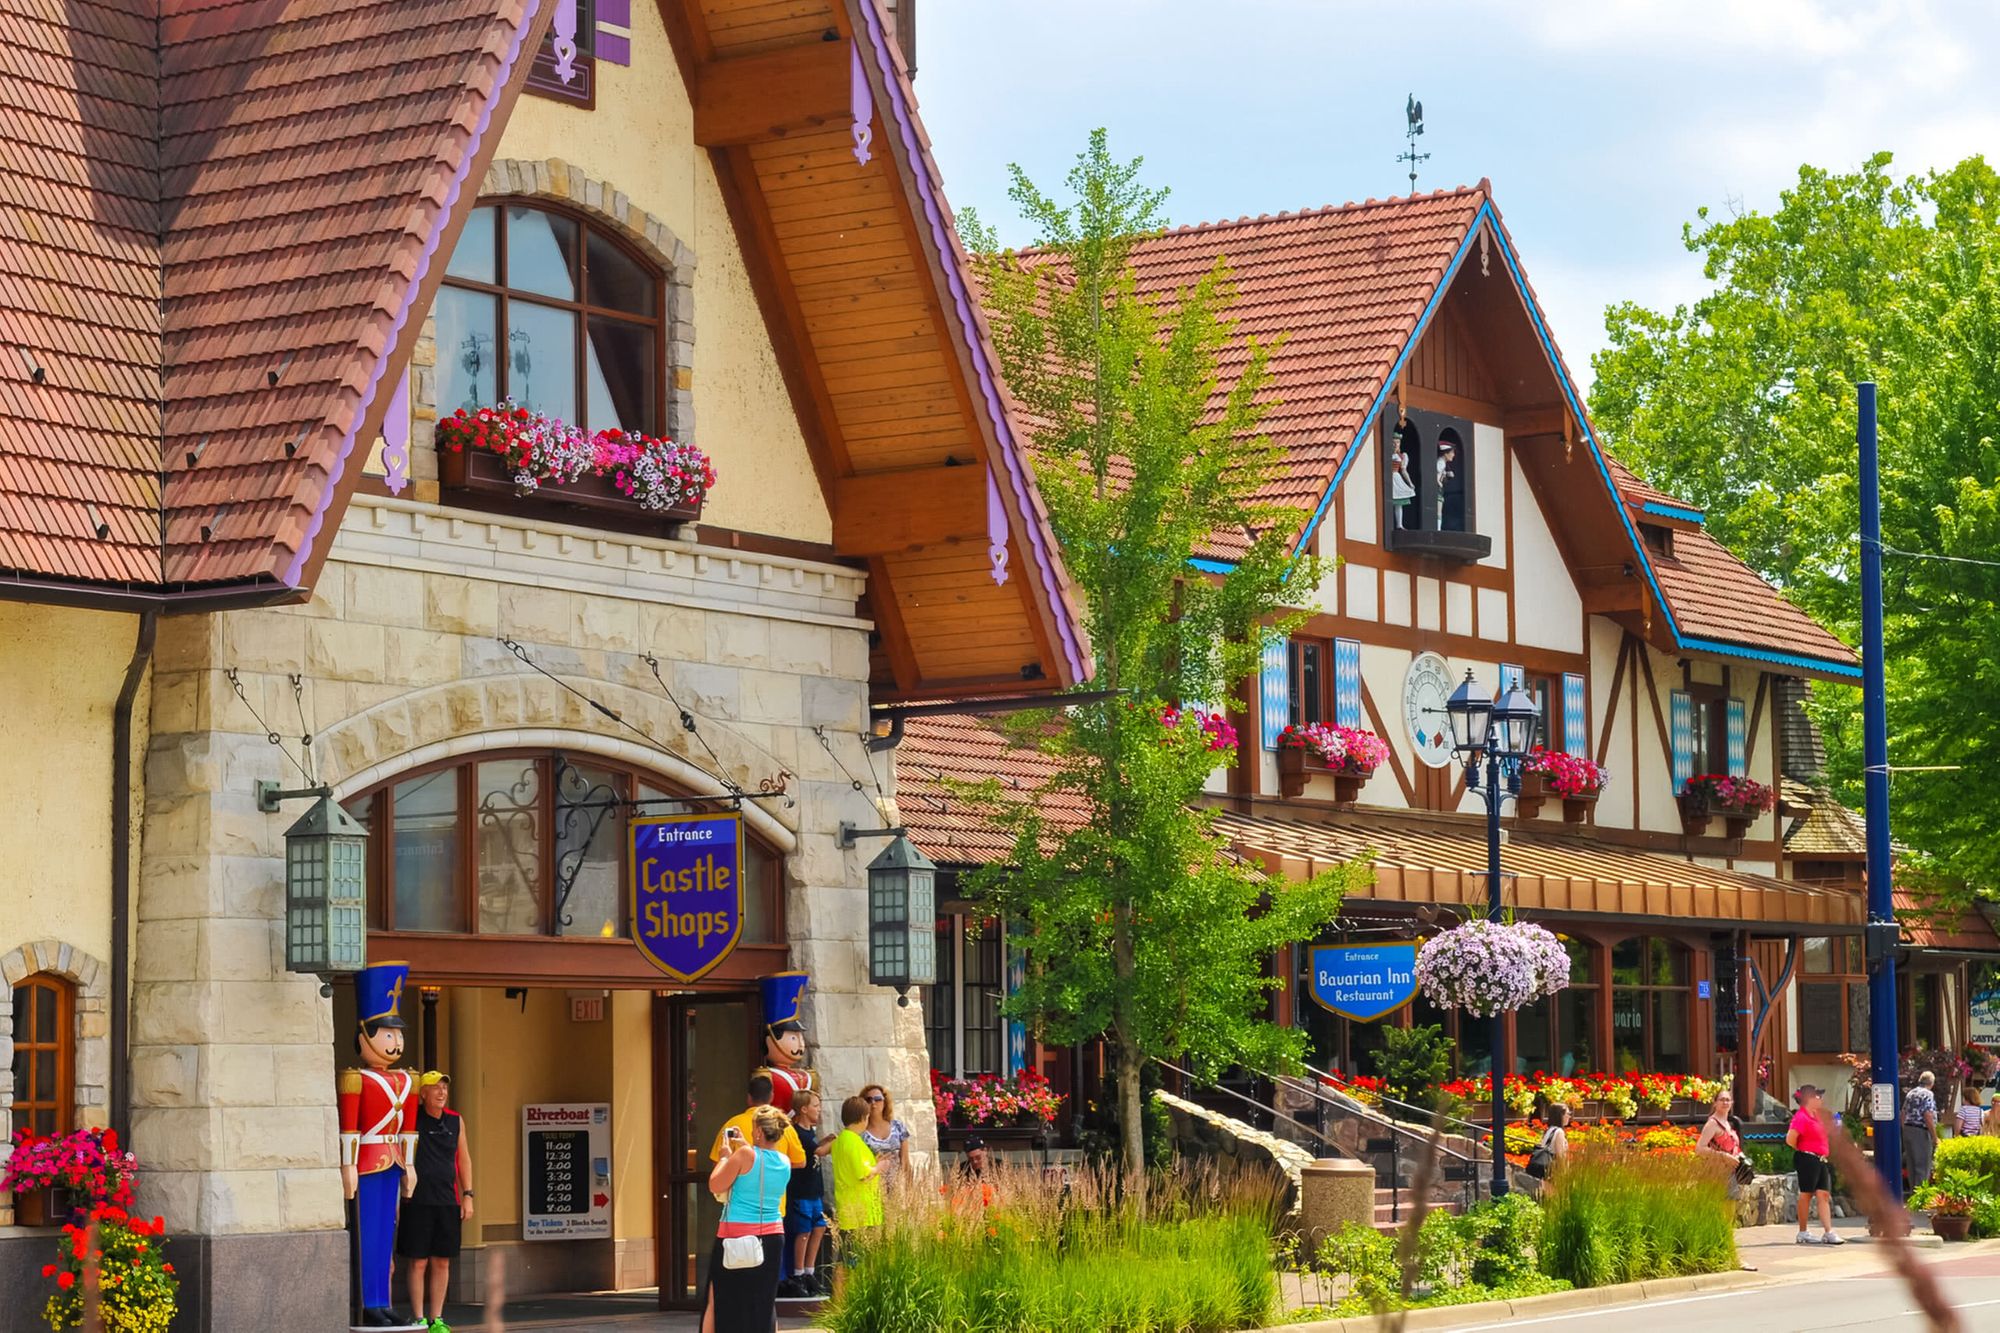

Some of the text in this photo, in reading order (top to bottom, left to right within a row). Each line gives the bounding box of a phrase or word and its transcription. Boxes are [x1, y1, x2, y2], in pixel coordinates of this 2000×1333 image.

[658, 827, 713, 842] Entrance
[642, 853, 731, 894] Castle
[644, 900, 729, 950] Shops
[1345, 952, 1379, 961] Entrance
[1319, 967, 1410, 987] Bavarian Inn
[1335, 988, 1394, 1002] Restaurant
[575, 1000, 600, 1020] EXIT
[527, 1108, 590, 1121] Riverboat
[546, 1141, 572, 1150] 11:00
[546, 1151, 572, 1160] 12:30
[546, 1161, 572, 1170] 2:00
[546, 1172, 572, 1181] 3:30
[546, 1183, 572, 1192] 5:00
[546, 1193, 572, 1202] 6:30
